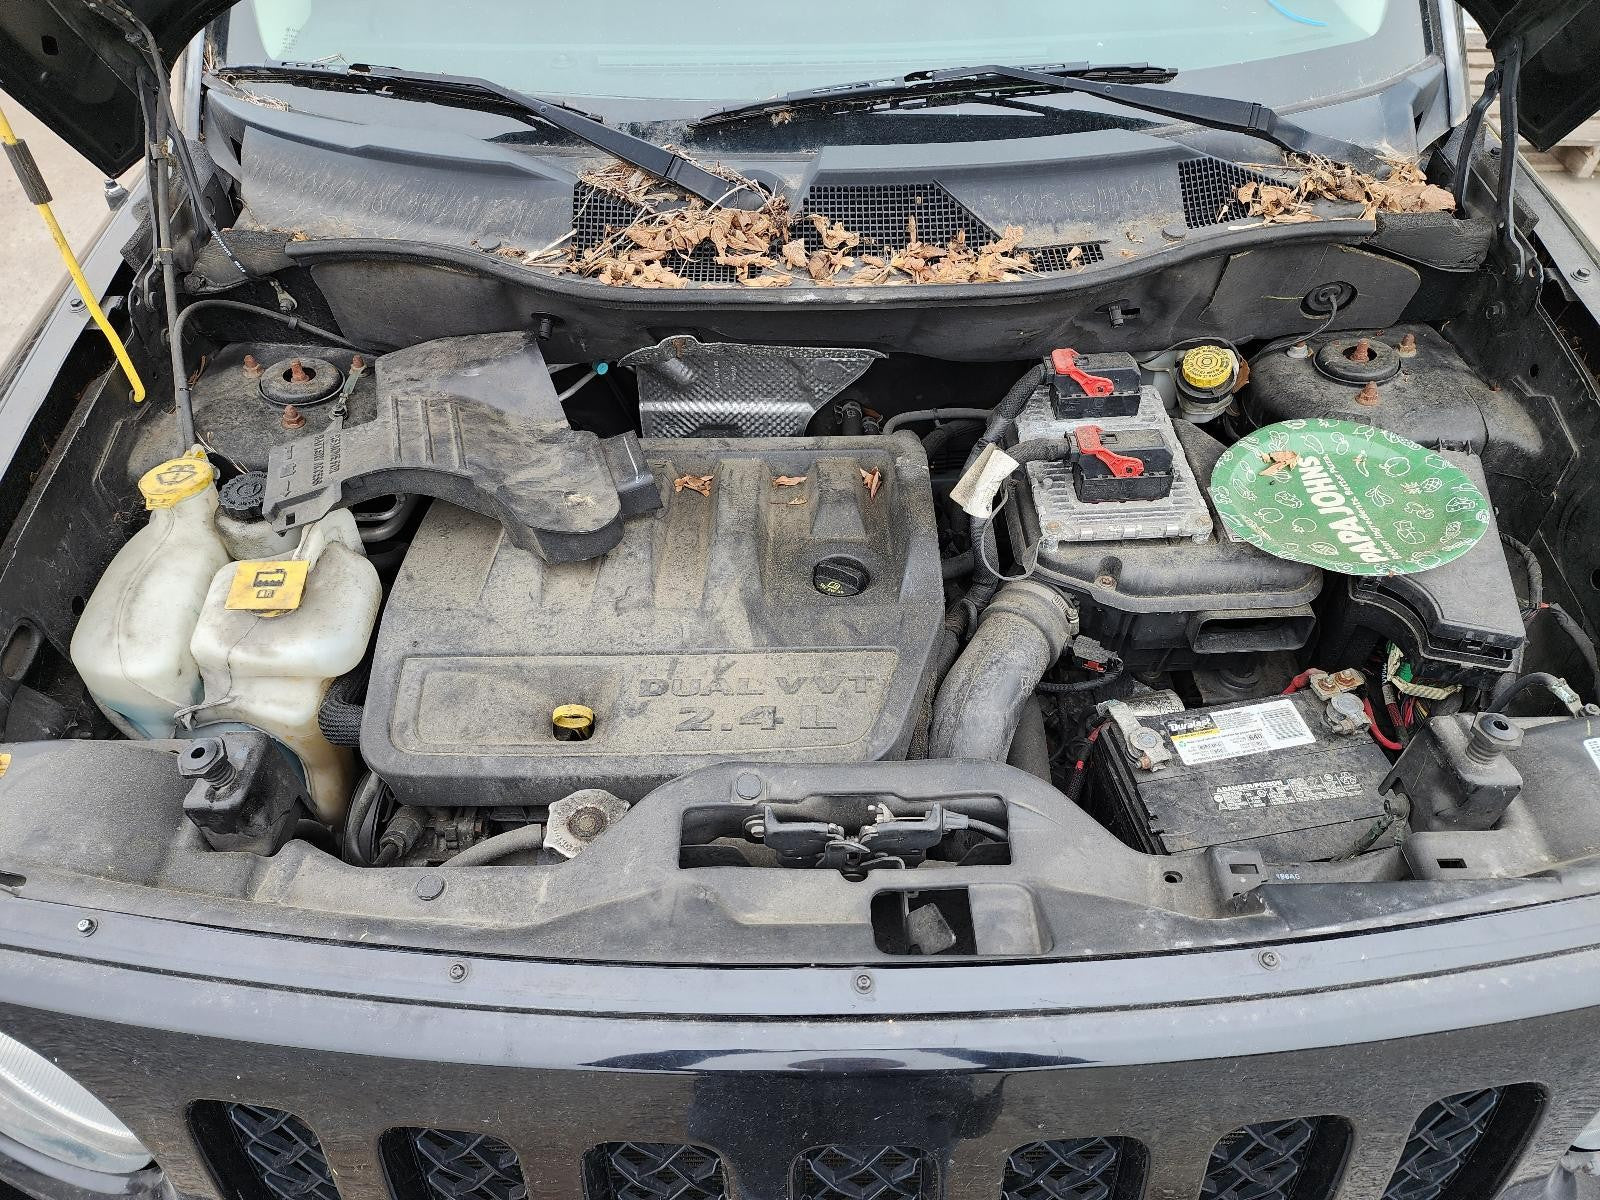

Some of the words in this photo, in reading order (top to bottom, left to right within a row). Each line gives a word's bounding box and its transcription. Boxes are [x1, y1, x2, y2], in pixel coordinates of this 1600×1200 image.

[313, 434, 325, 461] BATTERY
[329, 434, 341, 461] REMOVE
[311, 462, 324, 487] ACCESS
[1334, 473, 1354, 496] Better
[1380, 539, 1403, 560] Better
[638, 678, 764, 697] DUAL
[775, 675, 875, 695] VVT
[1167, 717, 1212, 732] Duralast
